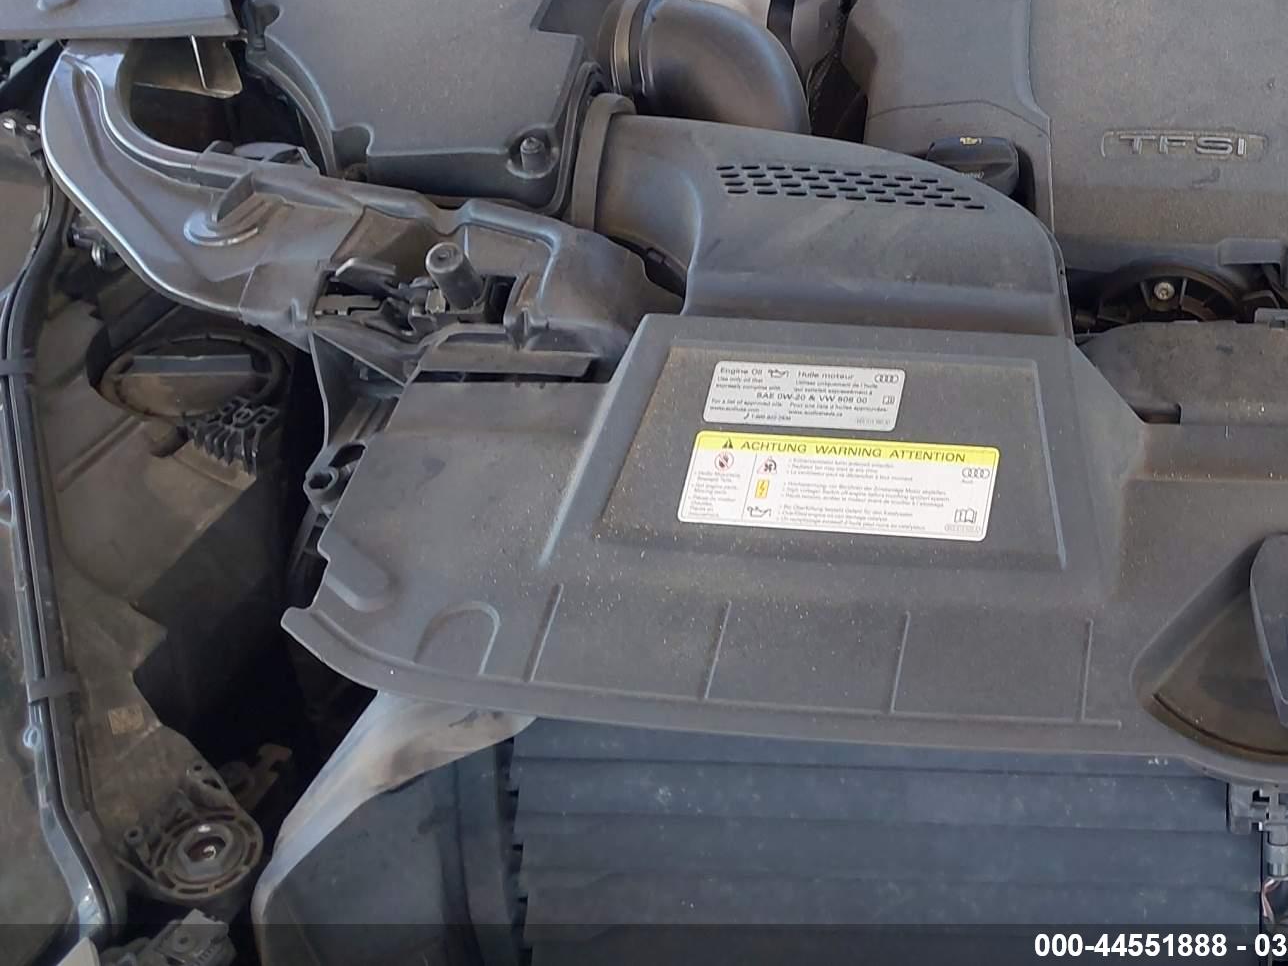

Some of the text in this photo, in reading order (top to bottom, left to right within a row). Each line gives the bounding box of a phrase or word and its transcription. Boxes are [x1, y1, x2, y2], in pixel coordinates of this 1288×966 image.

[1118, 135, 1247, 155] TFSI
[720, 368, 748, 376] Engine
[740, 441, 966, 462] ACHTUNG WARNING ATTENTION
